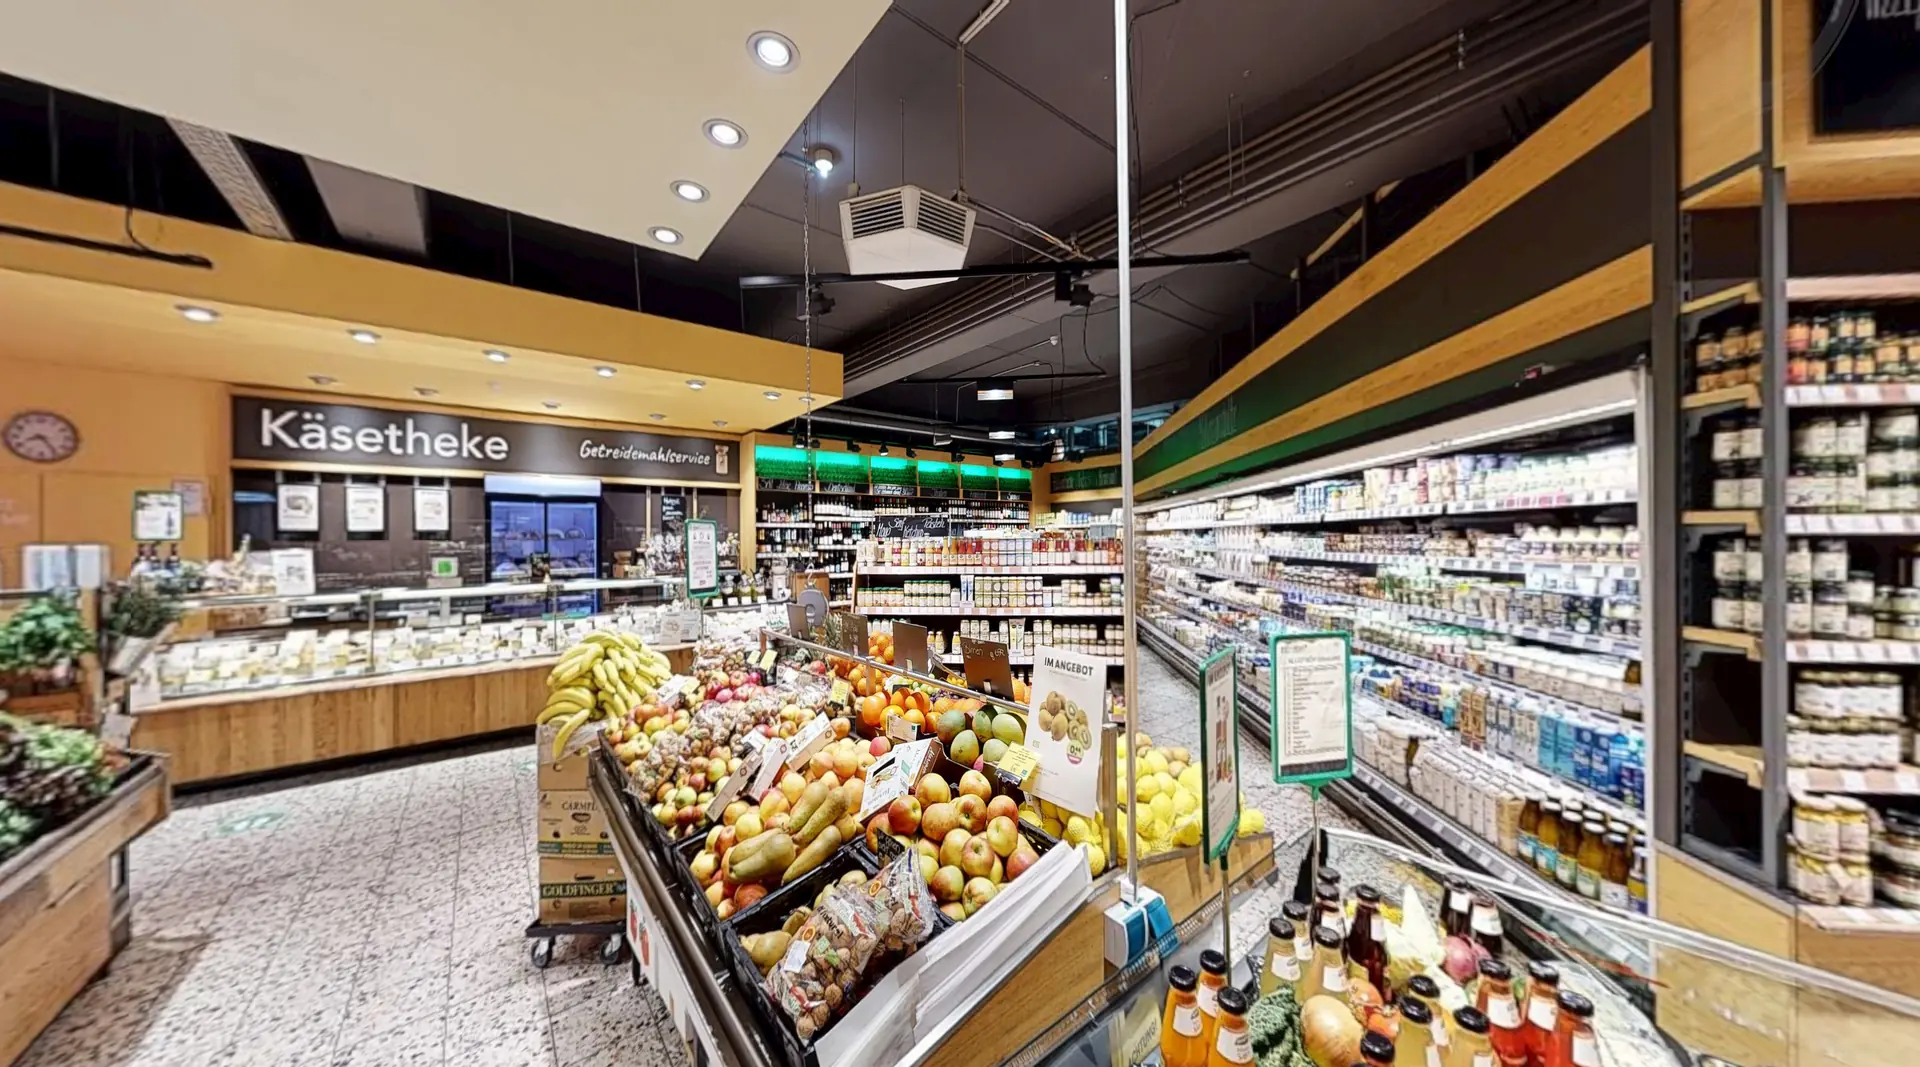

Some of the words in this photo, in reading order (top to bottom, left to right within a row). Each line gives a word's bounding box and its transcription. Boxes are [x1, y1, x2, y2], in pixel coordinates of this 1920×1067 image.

[261, 408, 509, 460] Käsetheke
[579, 439, 711, 466] Getreidemahlservice
[1044, 656, 1054, 668] IM
[1055, 660, 1094, 677] ANGEBOT
[542, 881, 614, 898] GOLDFINGER
